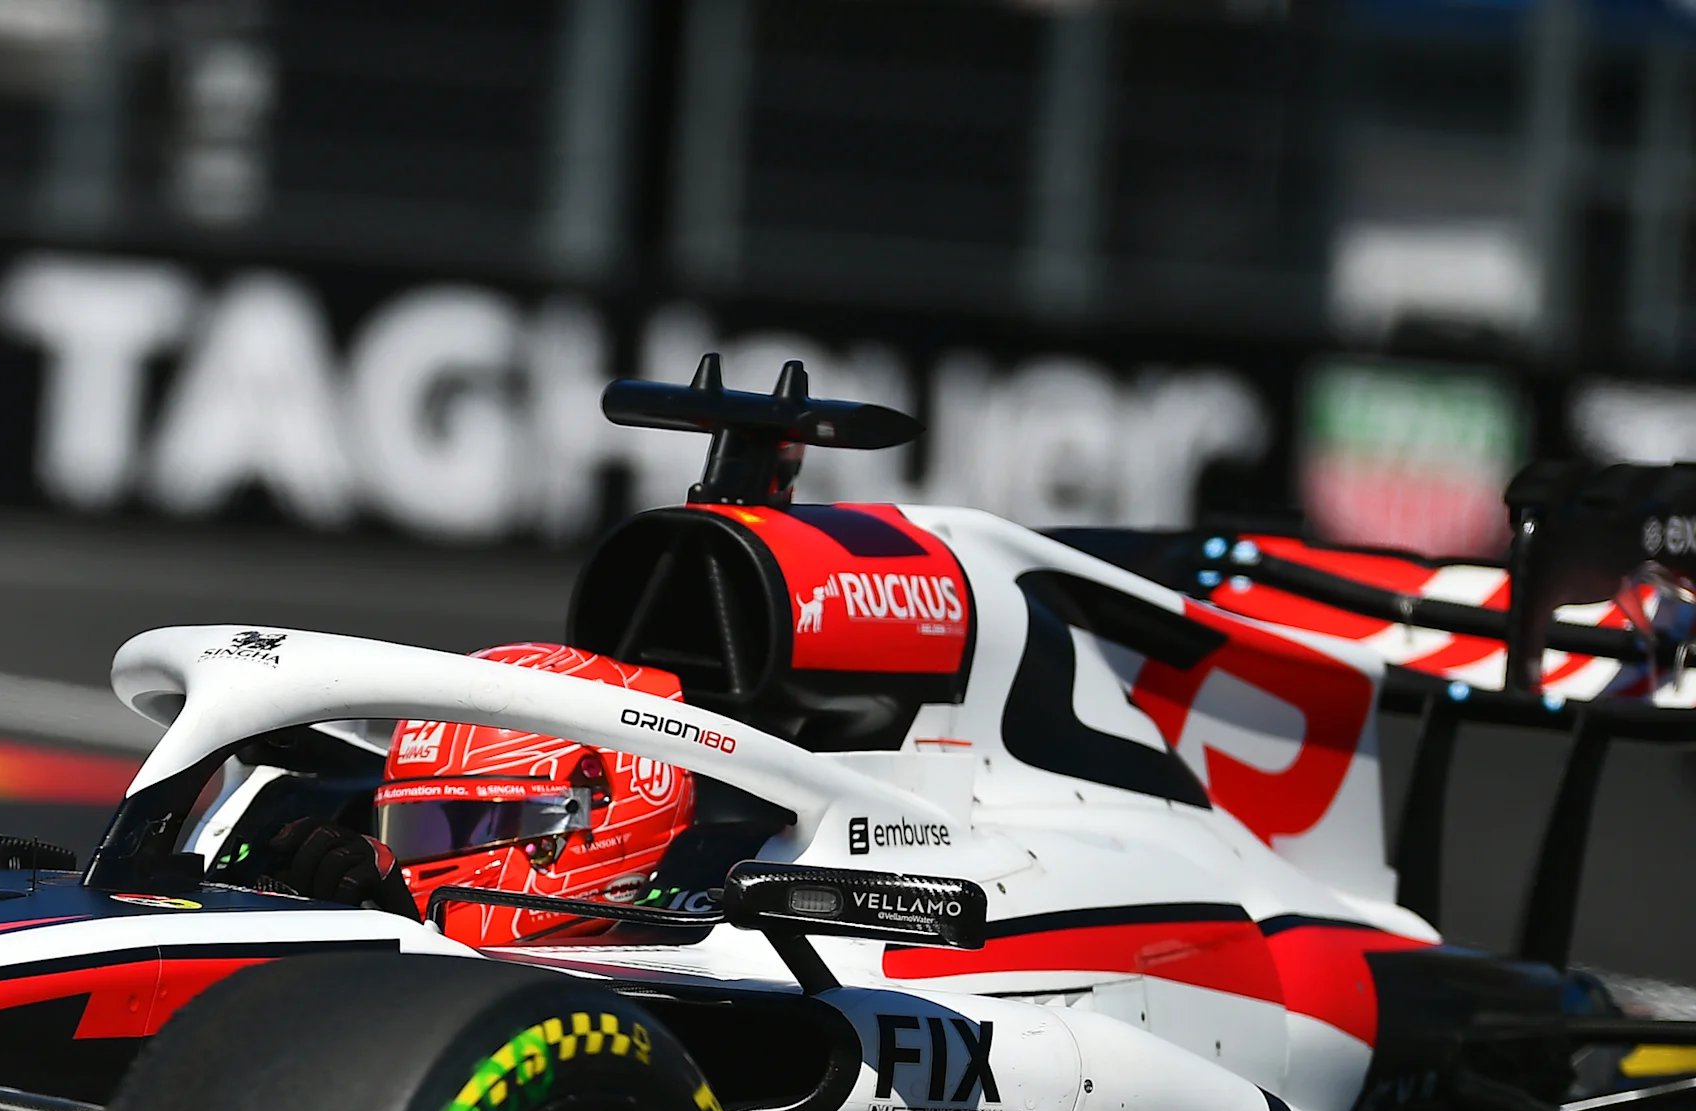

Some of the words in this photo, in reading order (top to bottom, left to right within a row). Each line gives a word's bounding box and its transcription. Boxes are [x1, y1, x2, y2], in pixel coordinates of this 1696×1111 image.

[838, 572, 963, 621] RUCKUS
[203, 648, 280, 664] SINGHA
[620, 708, 737, 754] ORION180
[384, 785, 442, 799] Automation
[444, 784, 469, 795] Inc.
[486, 785, 526, 794] SINGHA
[874, 816, 952, 848] emburse
[580, 836, 623, 854] MANSORY
[852, 891, 962, 917] VELLAMO
[877, 911, 935, 925] @VellamoWater
[874, 1014, 1002, 1103] FIX
